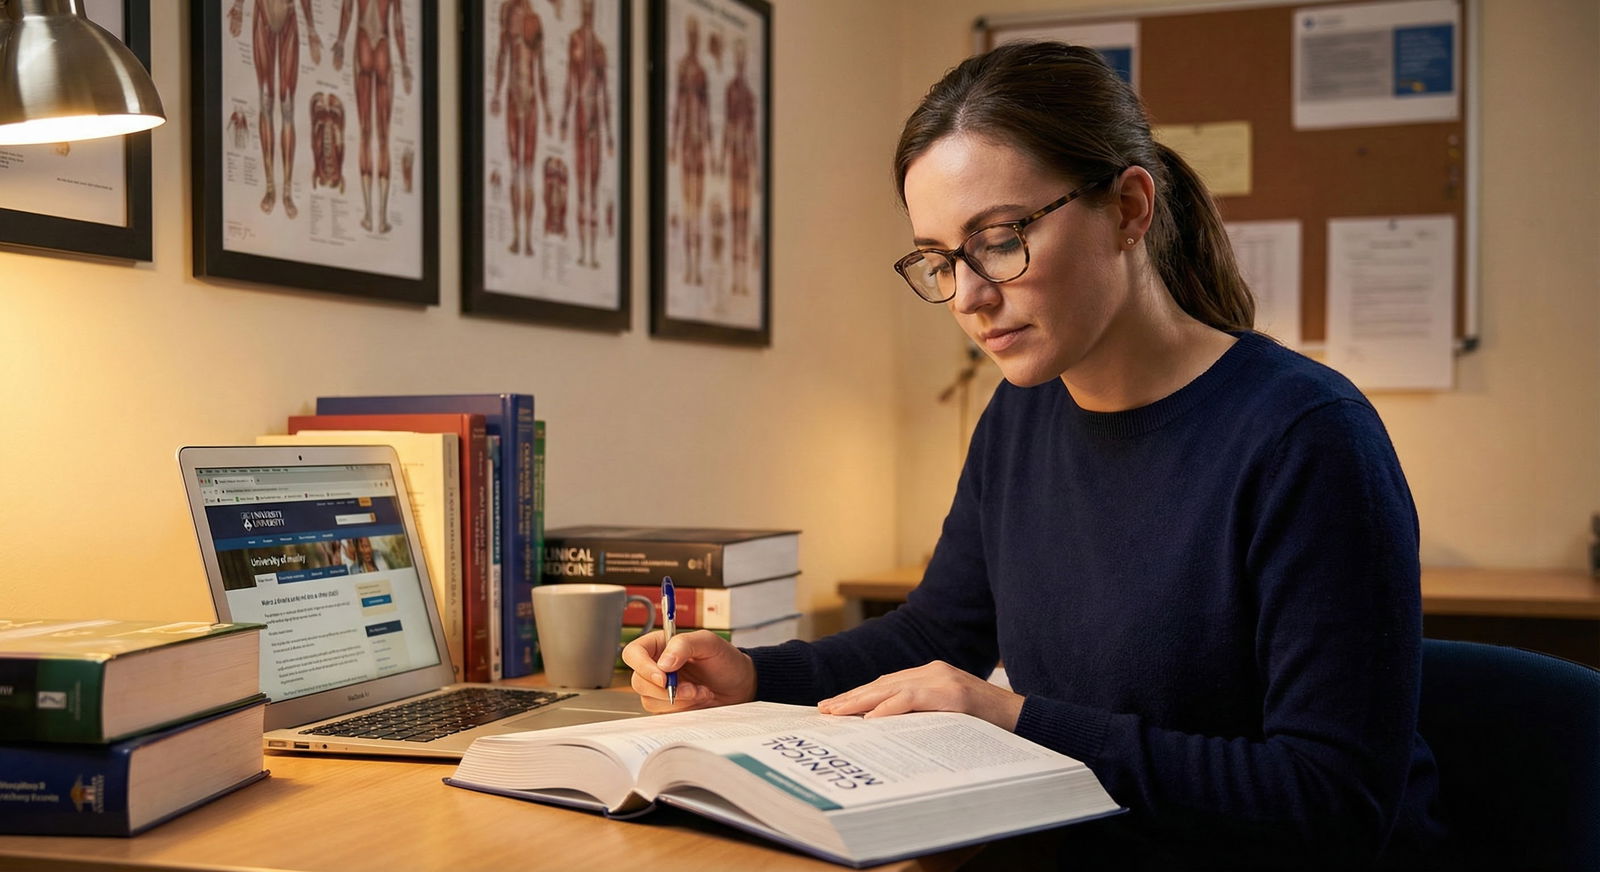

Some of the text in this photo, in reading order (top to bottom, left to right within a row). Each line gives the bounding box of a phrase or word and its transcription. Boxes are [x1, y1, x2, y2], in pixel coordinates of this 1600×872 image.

[544, 546, 594, 562] LINICAL
[544, 561, 594, 577] EDICINE
[761, 739, 858, 790] CLINICAL
[777, 735, 884, 786] MEDICINE
